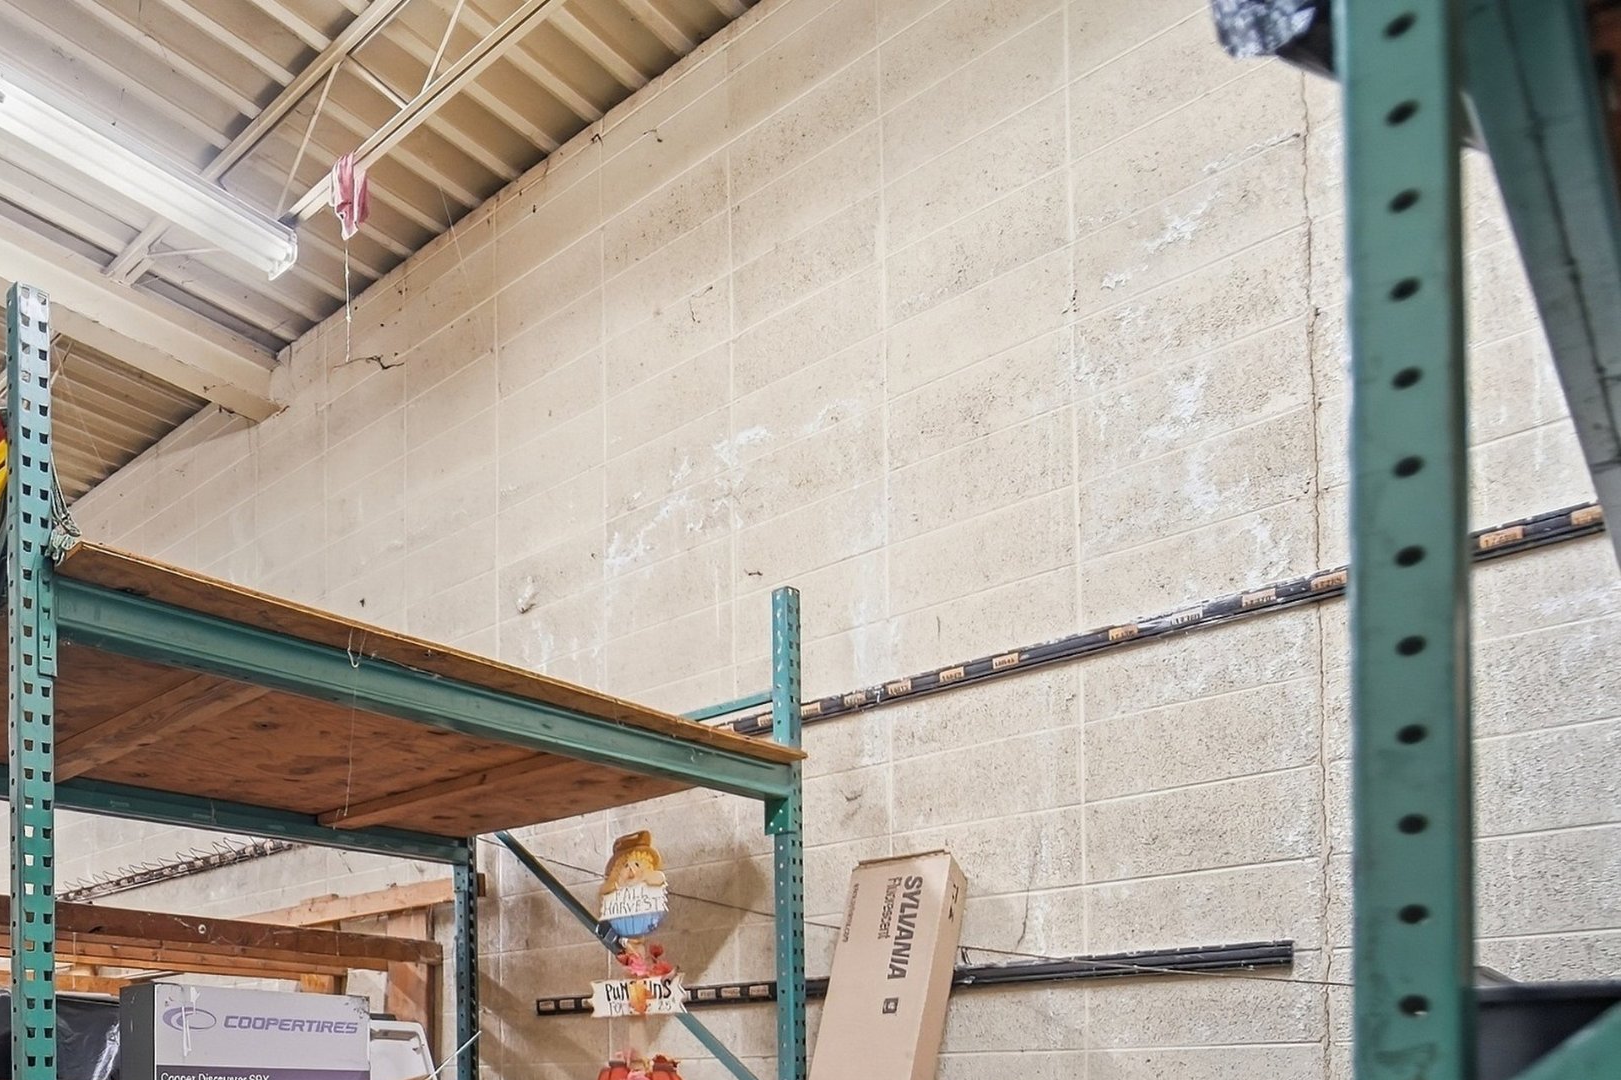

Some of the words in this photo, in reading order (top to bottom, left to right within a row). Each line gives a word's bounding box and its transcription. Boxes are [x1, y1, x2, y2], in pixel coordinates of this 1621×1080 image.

[603, 896, 661, 916] HARVEST
[877, 877, 903, 940] Fluorescent
[887, 875, 924, 980] SYLVANIA
